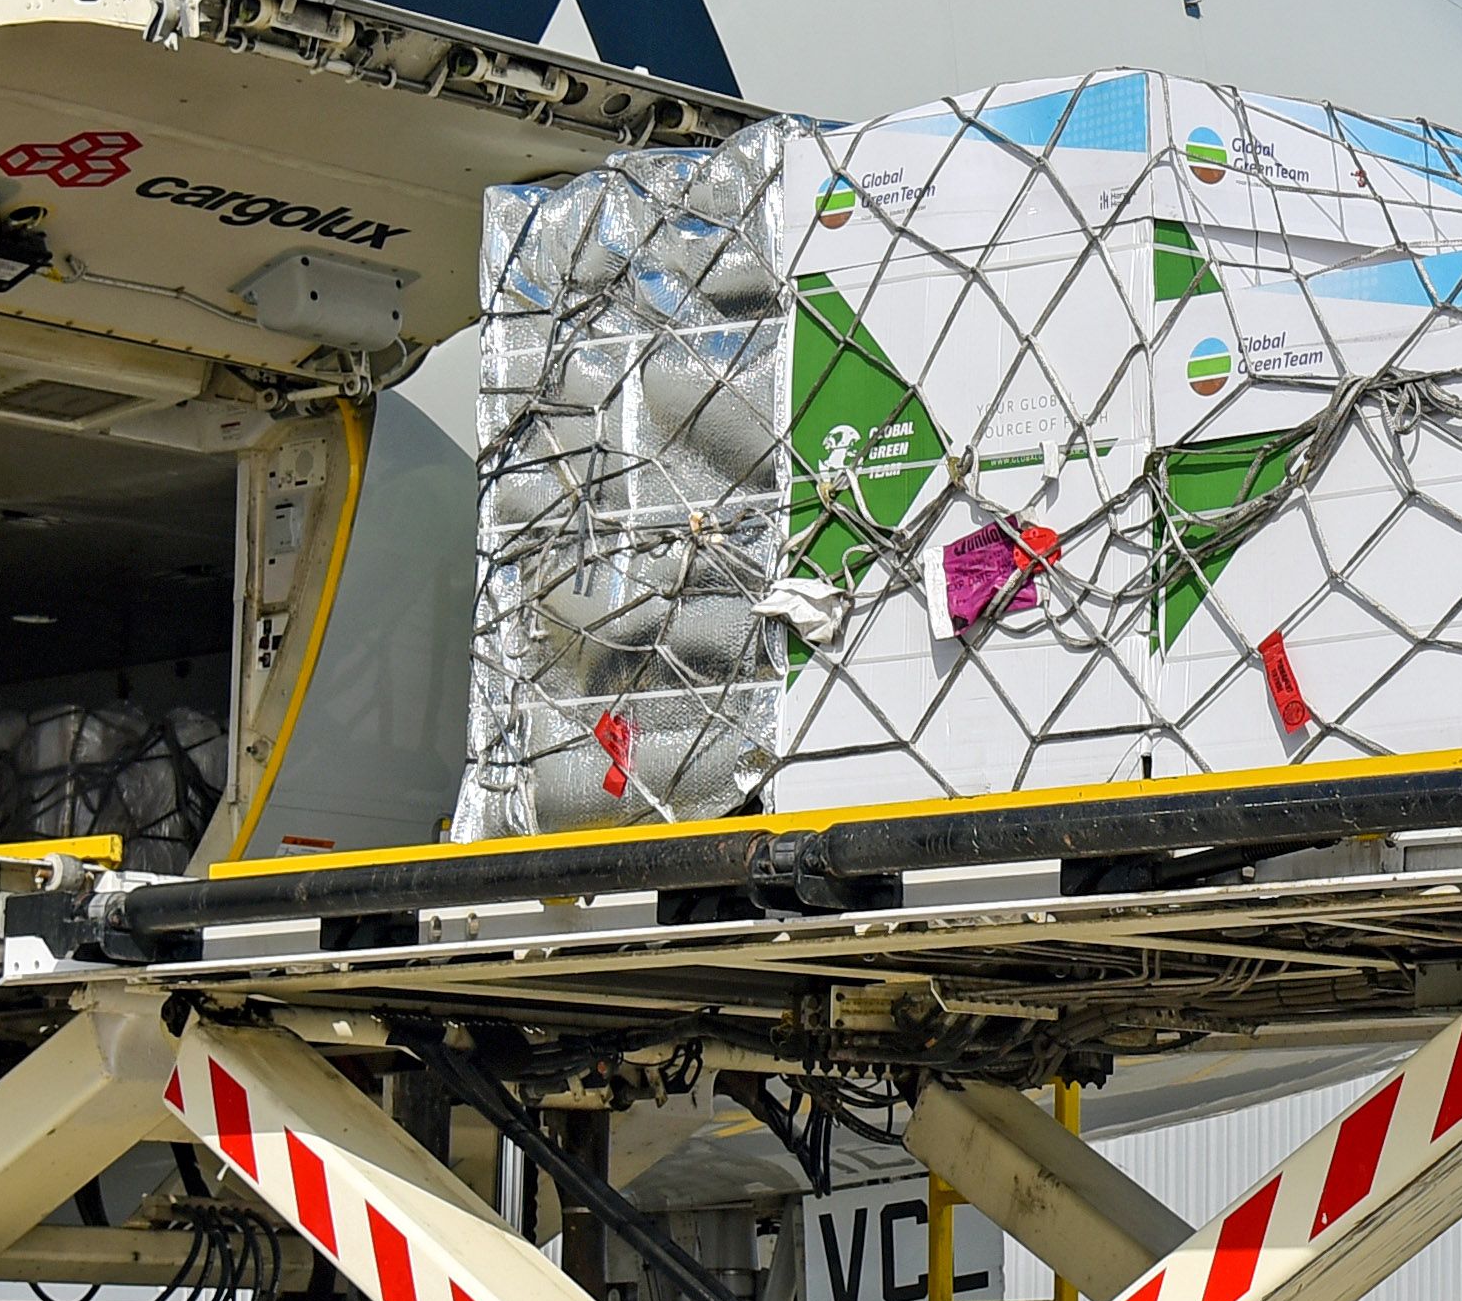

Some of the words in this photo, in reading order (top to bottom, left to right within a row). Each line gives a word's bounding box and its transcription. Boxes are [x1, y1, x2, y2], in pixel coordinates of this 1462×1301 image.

[1232, 137, 1274, 158] Global
[861, 167, 904, 189] Global
[135, 175, 412, 251] cargolux
[1237, 331, 1287, 353] Global
[1020, 392, 1075, 411] GLOBL
[868, 421, 915, 440] GLOBAL
[984, 420, 1032, 439] OURCE
[1038, 417, 1057, 432] OF
[868, 441, 909, 459] GREEN
